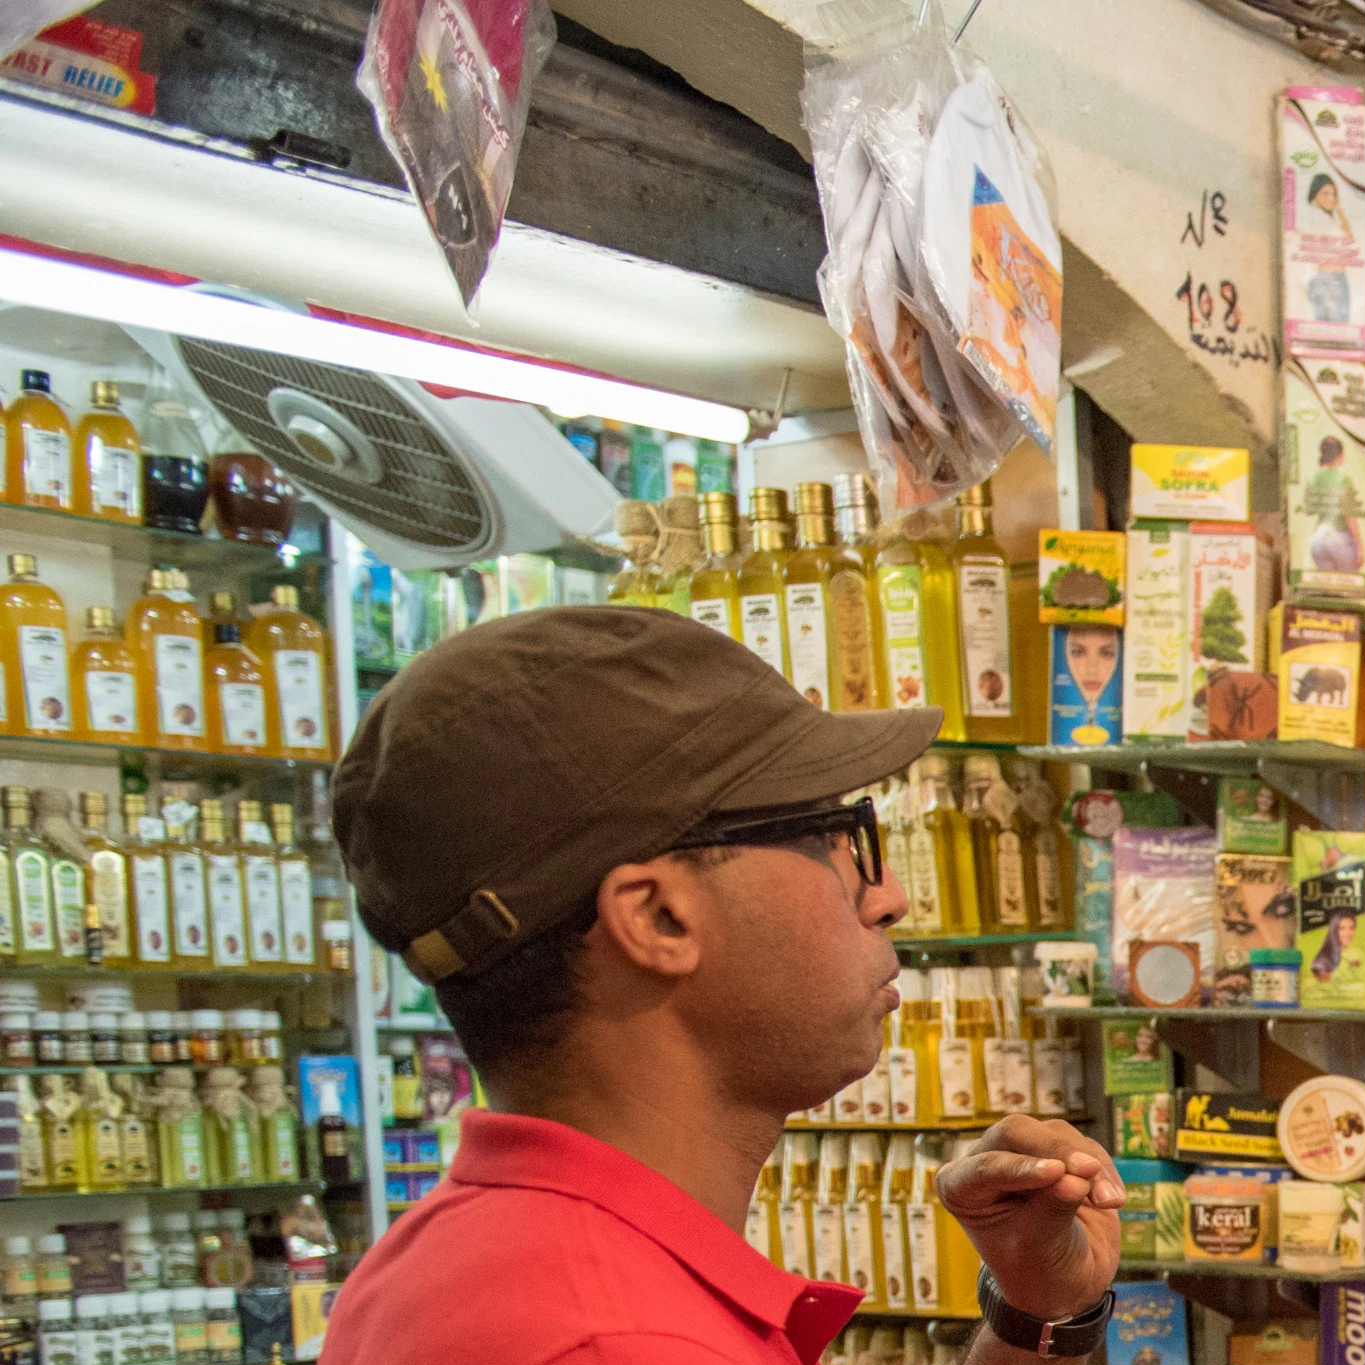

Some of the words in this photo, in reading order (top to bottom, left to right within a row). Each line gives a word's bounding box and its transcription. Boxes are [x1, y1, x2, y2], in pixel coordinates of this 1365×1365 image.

[64, 65, 125, 98] RELIEF
[1175, 271, 1241, 333] 108
[1183, 1135, 1216, 1149] Black
[1224, 1138, 1250, 1150] Seed
